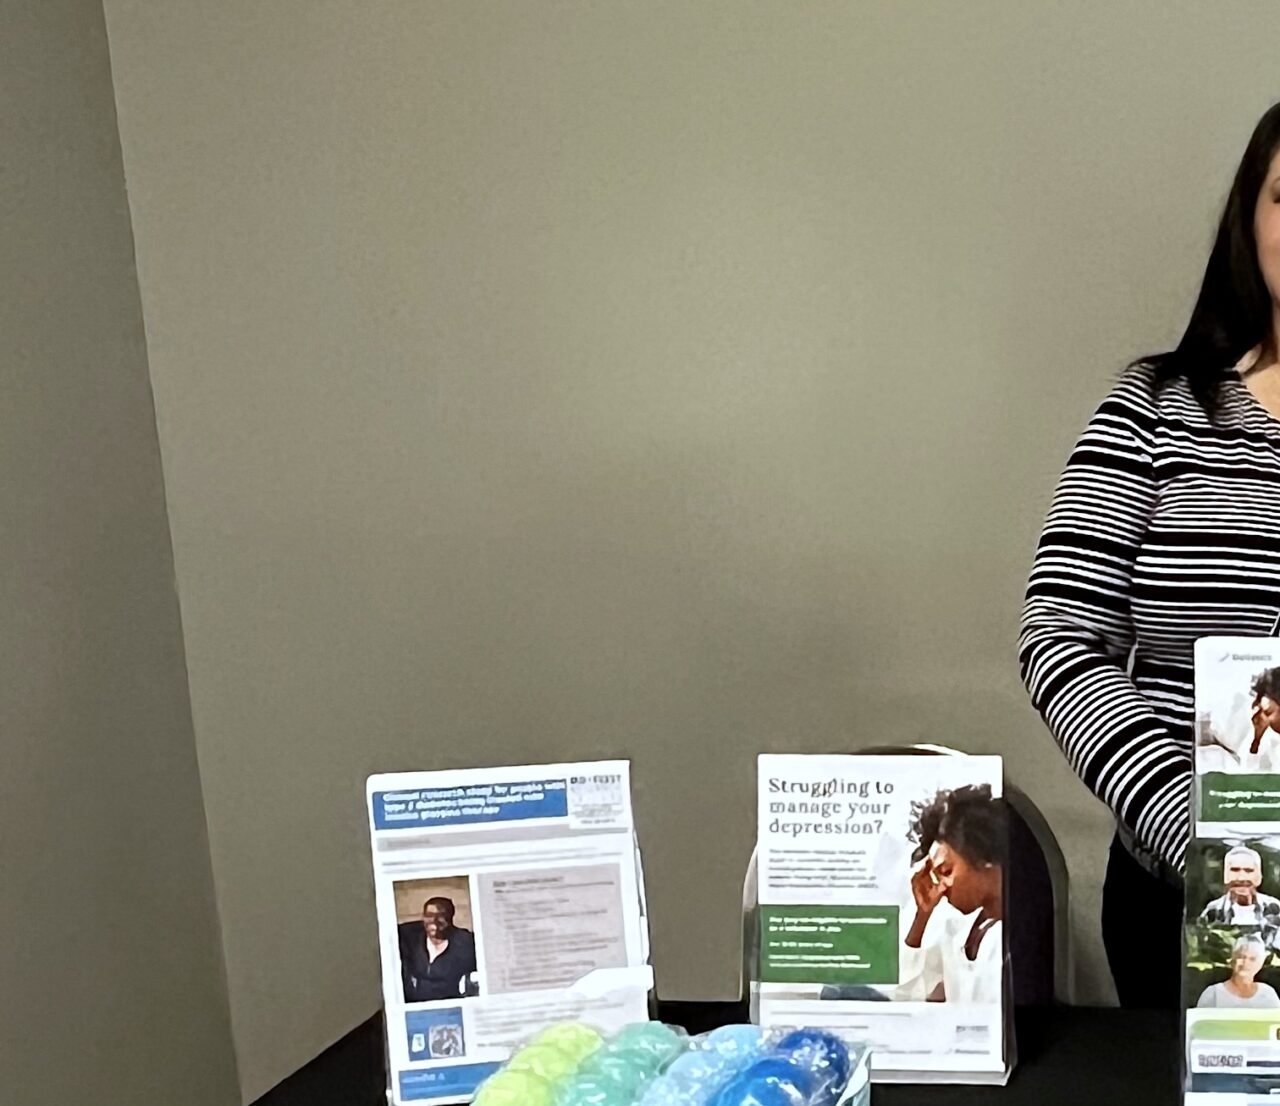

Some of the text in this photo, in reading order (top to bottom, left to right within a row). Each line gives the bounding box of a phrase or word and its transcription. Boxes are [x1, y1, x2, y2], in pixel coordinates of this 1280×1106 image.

[768, 777, 895, 798] Struggling to
[769, 802, 892, 821] manage your
[768, 818, 884, 838] depression?
